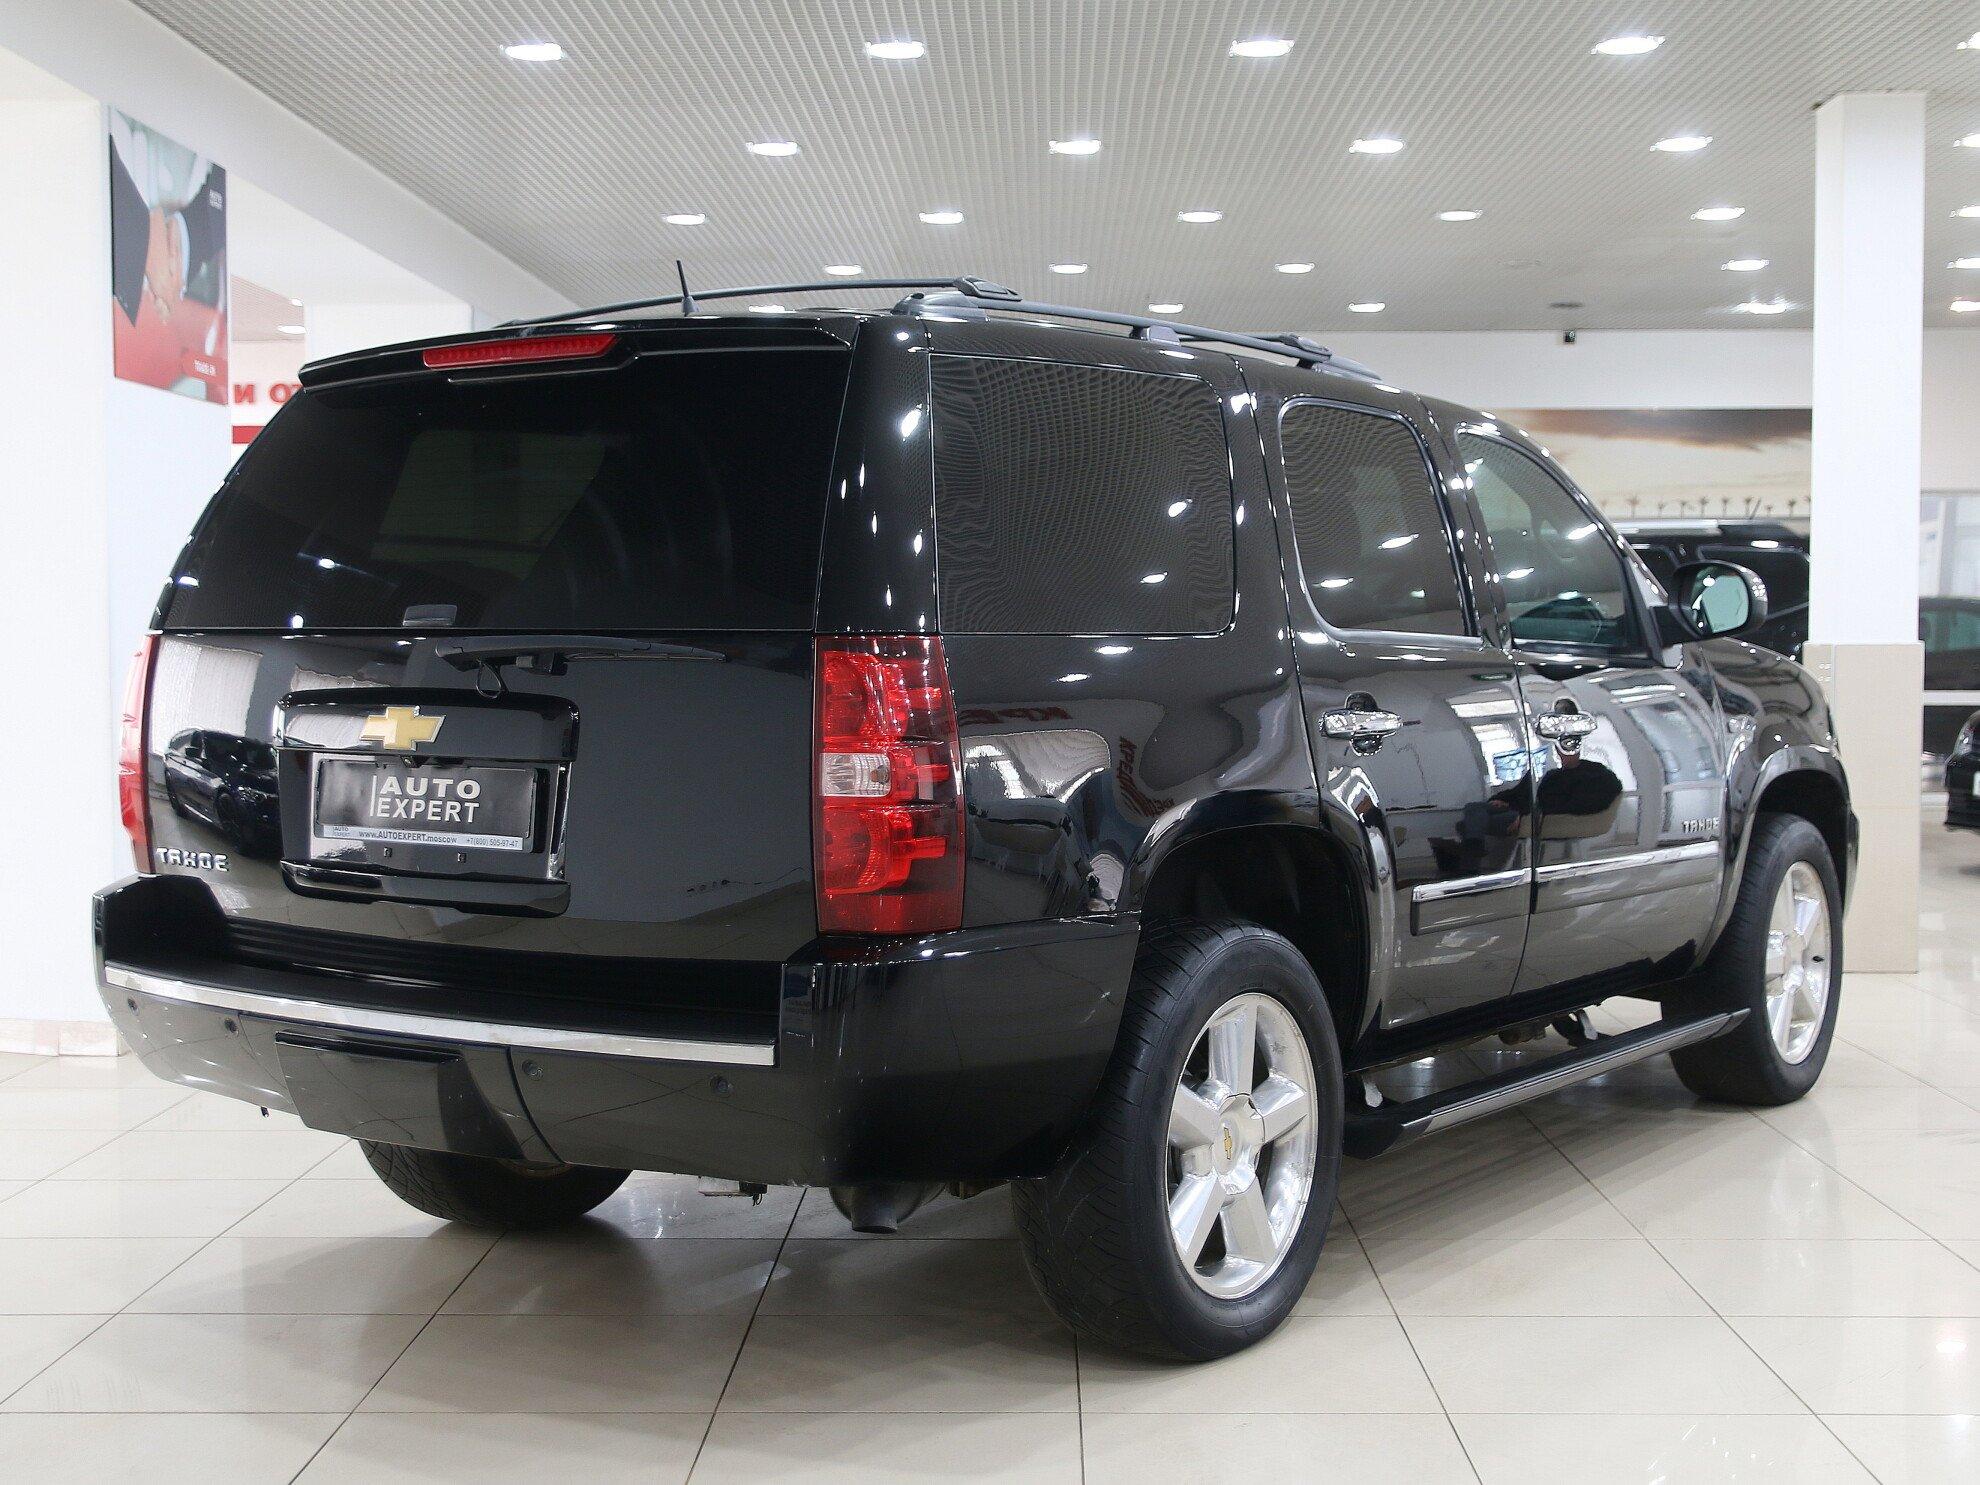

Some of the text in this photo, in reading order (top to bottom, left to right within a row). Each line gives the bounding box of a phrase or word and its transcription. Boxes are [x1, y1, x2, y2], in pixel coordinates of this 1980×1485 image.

[379, 776, 481, 800] AUTO
[376, 797, 480, 823] EXPERT
[1682, 817, 1720, 832] TAHOE
[156, 847, 229, 872] TAHOE
